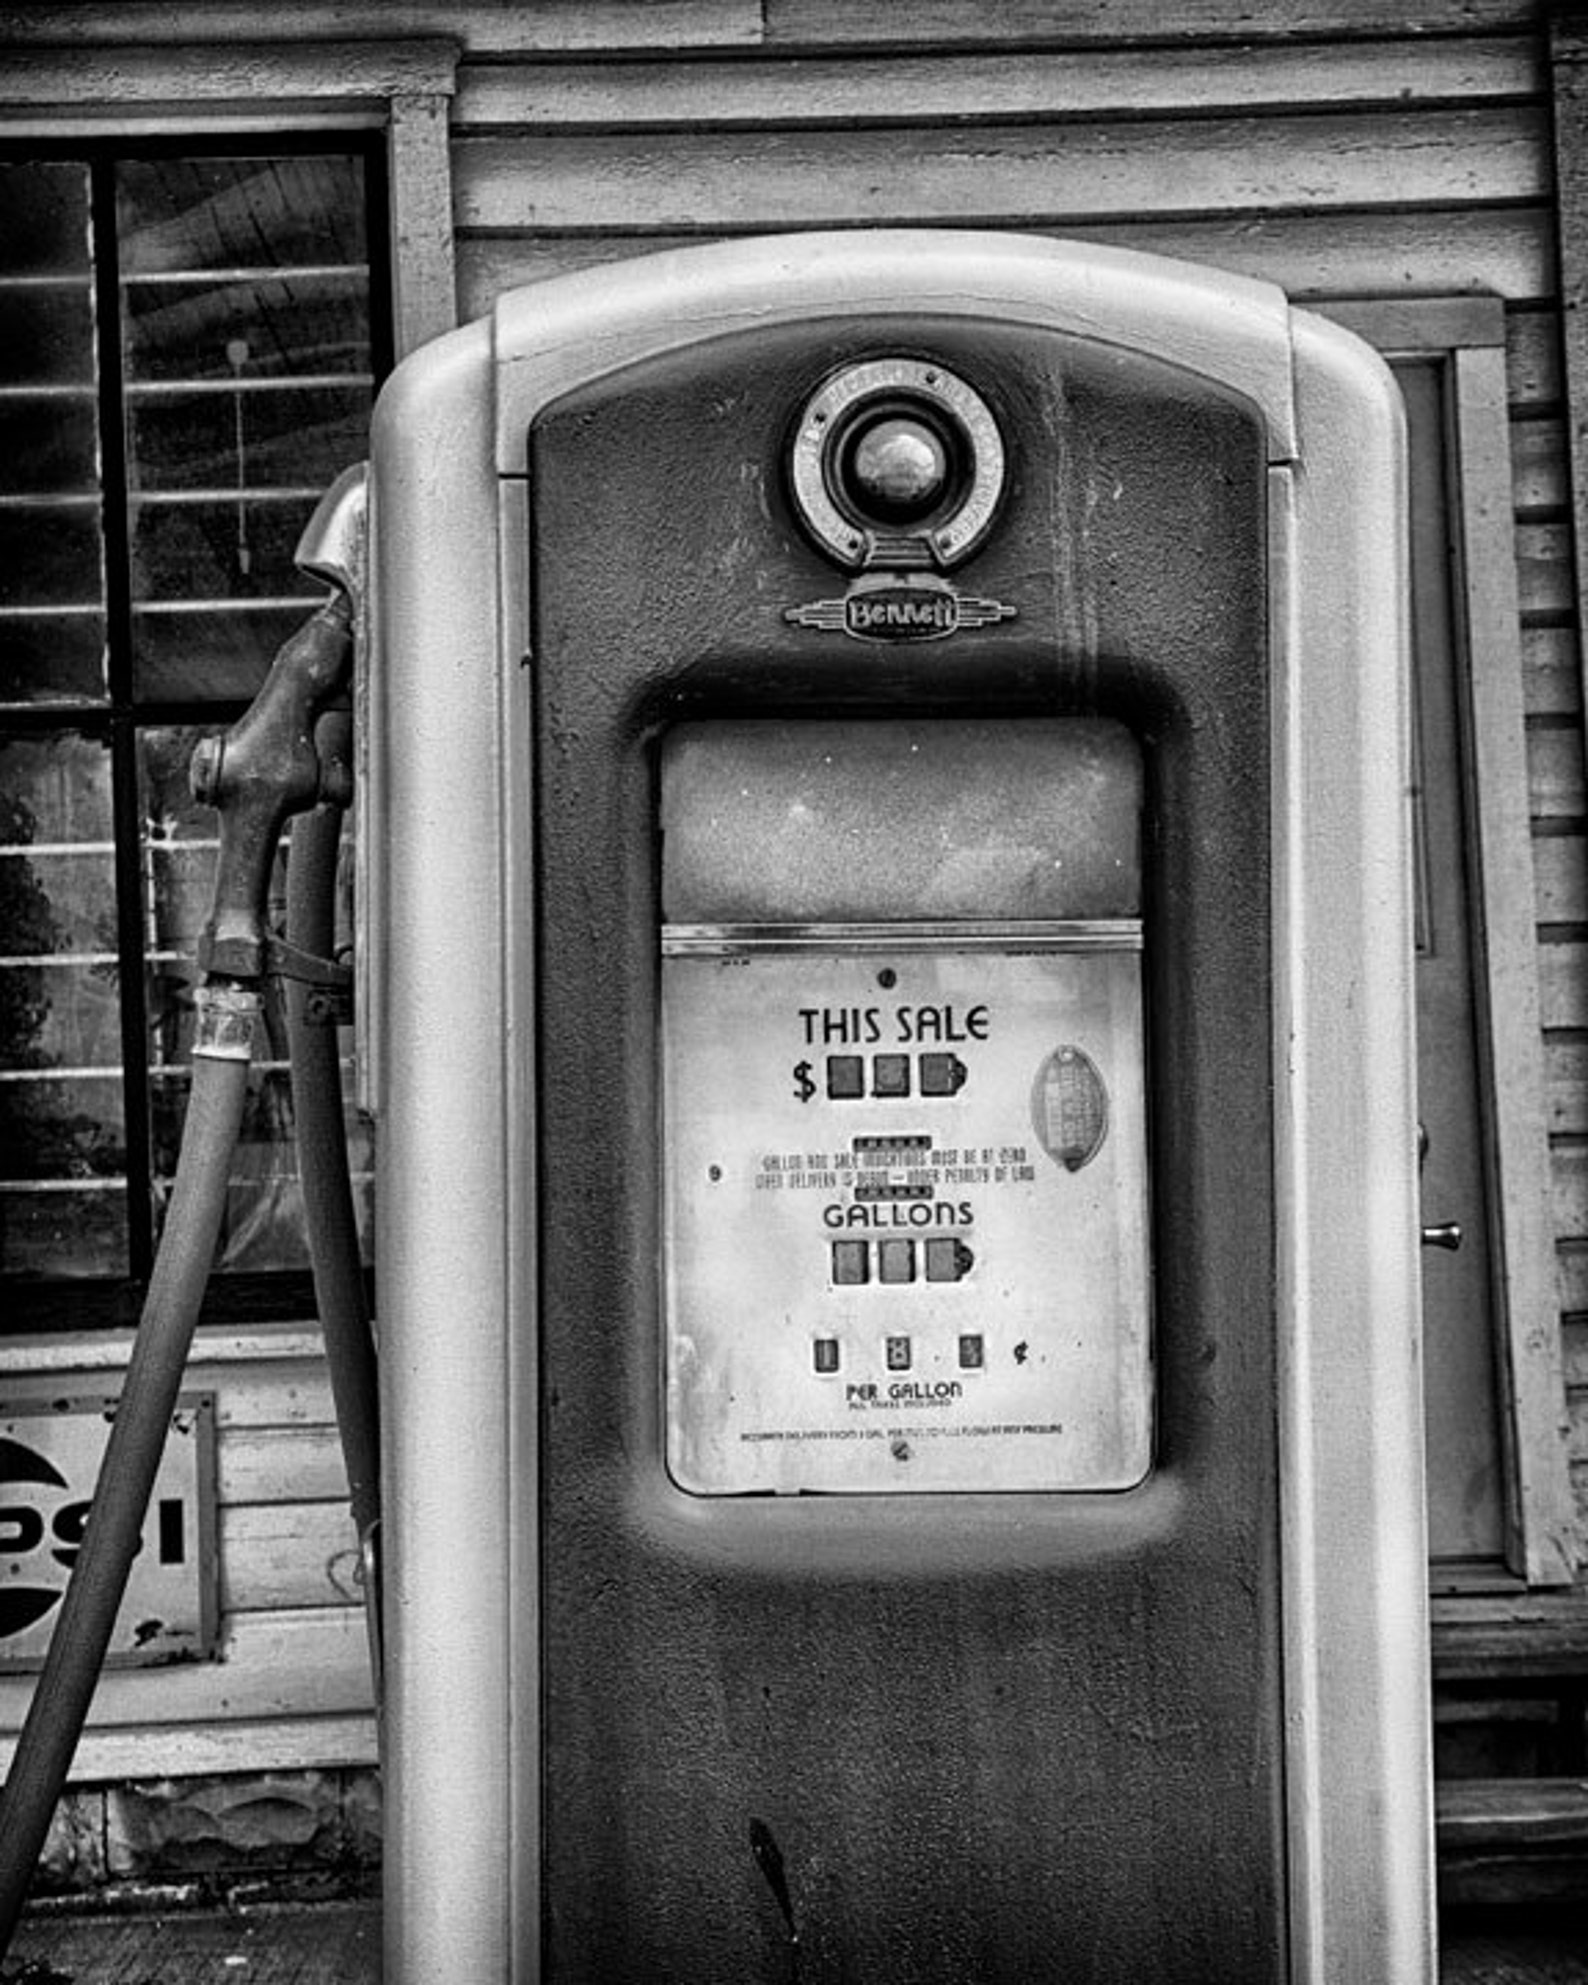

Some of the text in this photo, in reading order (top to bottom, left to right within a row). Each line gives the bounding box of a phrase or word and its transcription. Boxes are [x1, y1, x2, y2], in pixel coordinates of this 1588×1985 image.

[850, 599, 952, 628] Bennett
[798, 1004, 989, 1044] THIS SALE
[792, 1060, 817, 1103] $
[823, 1202, 974, 1229] GALLONS
[846, 1381, 963, 1401] PER GALLON
